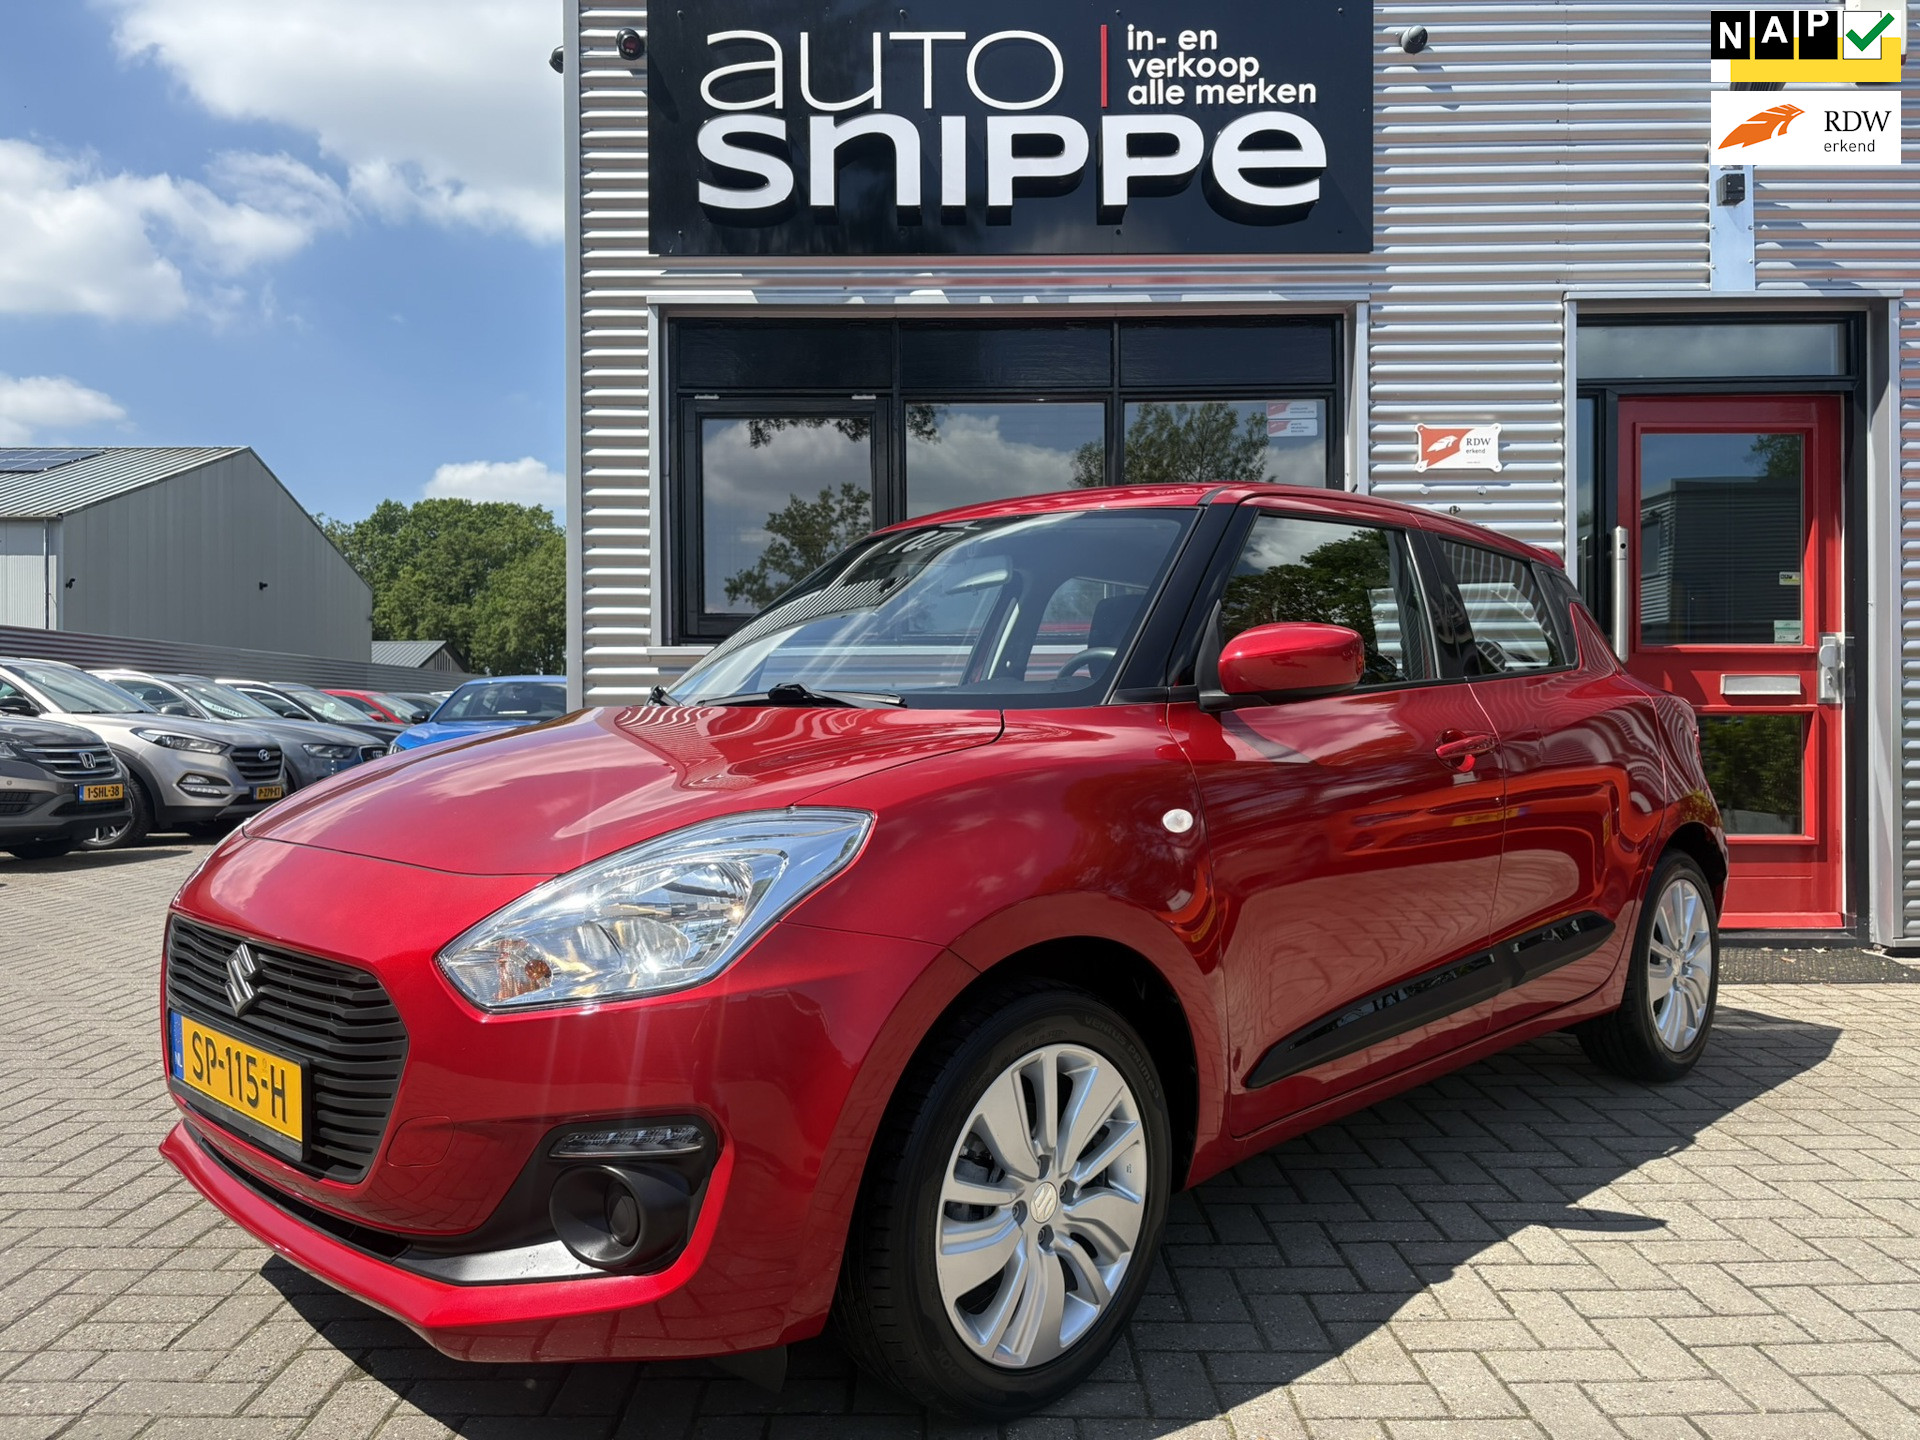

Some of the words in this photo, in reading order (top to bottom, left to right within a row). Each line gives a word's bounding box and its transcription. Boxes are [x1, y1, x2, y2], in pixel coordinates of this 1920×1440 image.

[1127, 24, 1168, 51] in-
[1178, 30, 1218, 51] en
[1127, 53, 1260, 83] verkoop
[1127, 79, 1186, 106] alle
[1196, 79, 1318, 105] merken
[1466, 437, 1491, 446] RDW
[87, 786, 120, 798] 1-SHL-38
[192, 1030, 288, 1124] SP-115-H
